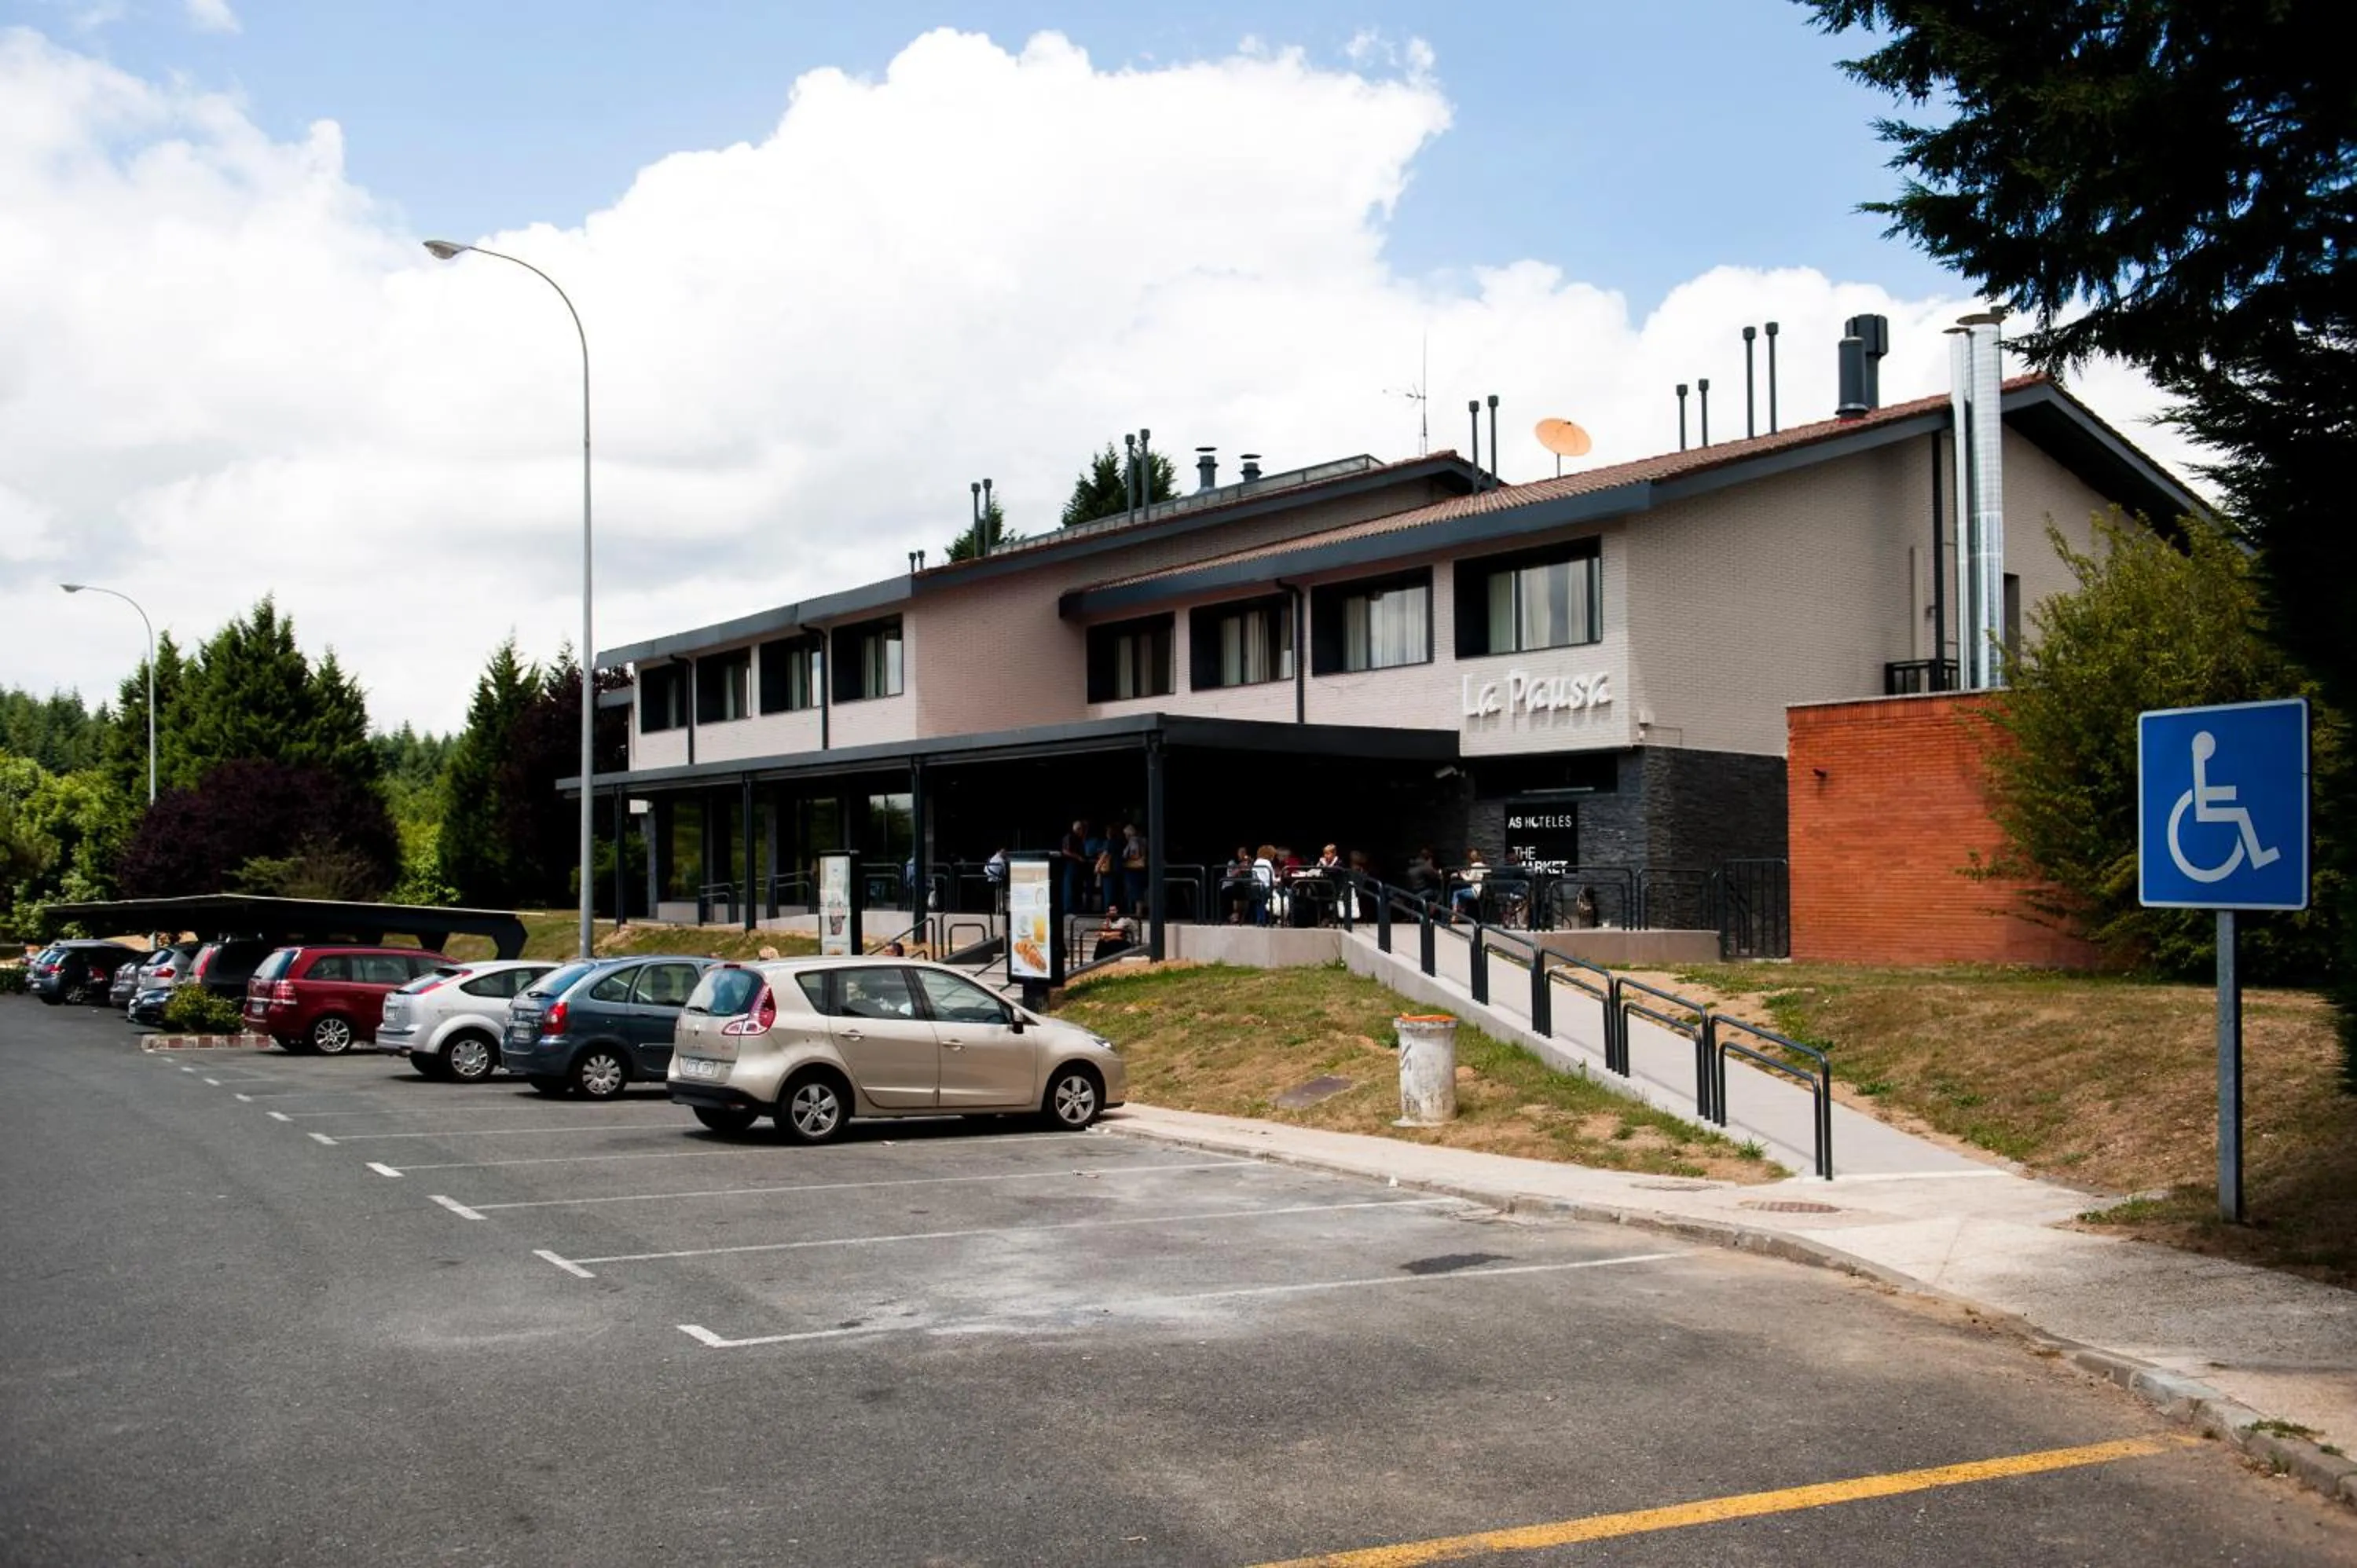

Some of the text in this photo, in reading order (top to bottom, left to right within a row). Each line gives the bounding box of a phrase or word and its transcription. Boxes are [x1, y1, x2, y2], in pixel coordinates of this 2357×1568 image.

[1463, 669, 1613, 716] La Pausa
[1508, 815, 1572, 829] AS HOTELES
[1512, 846, 1536, 860] THE
